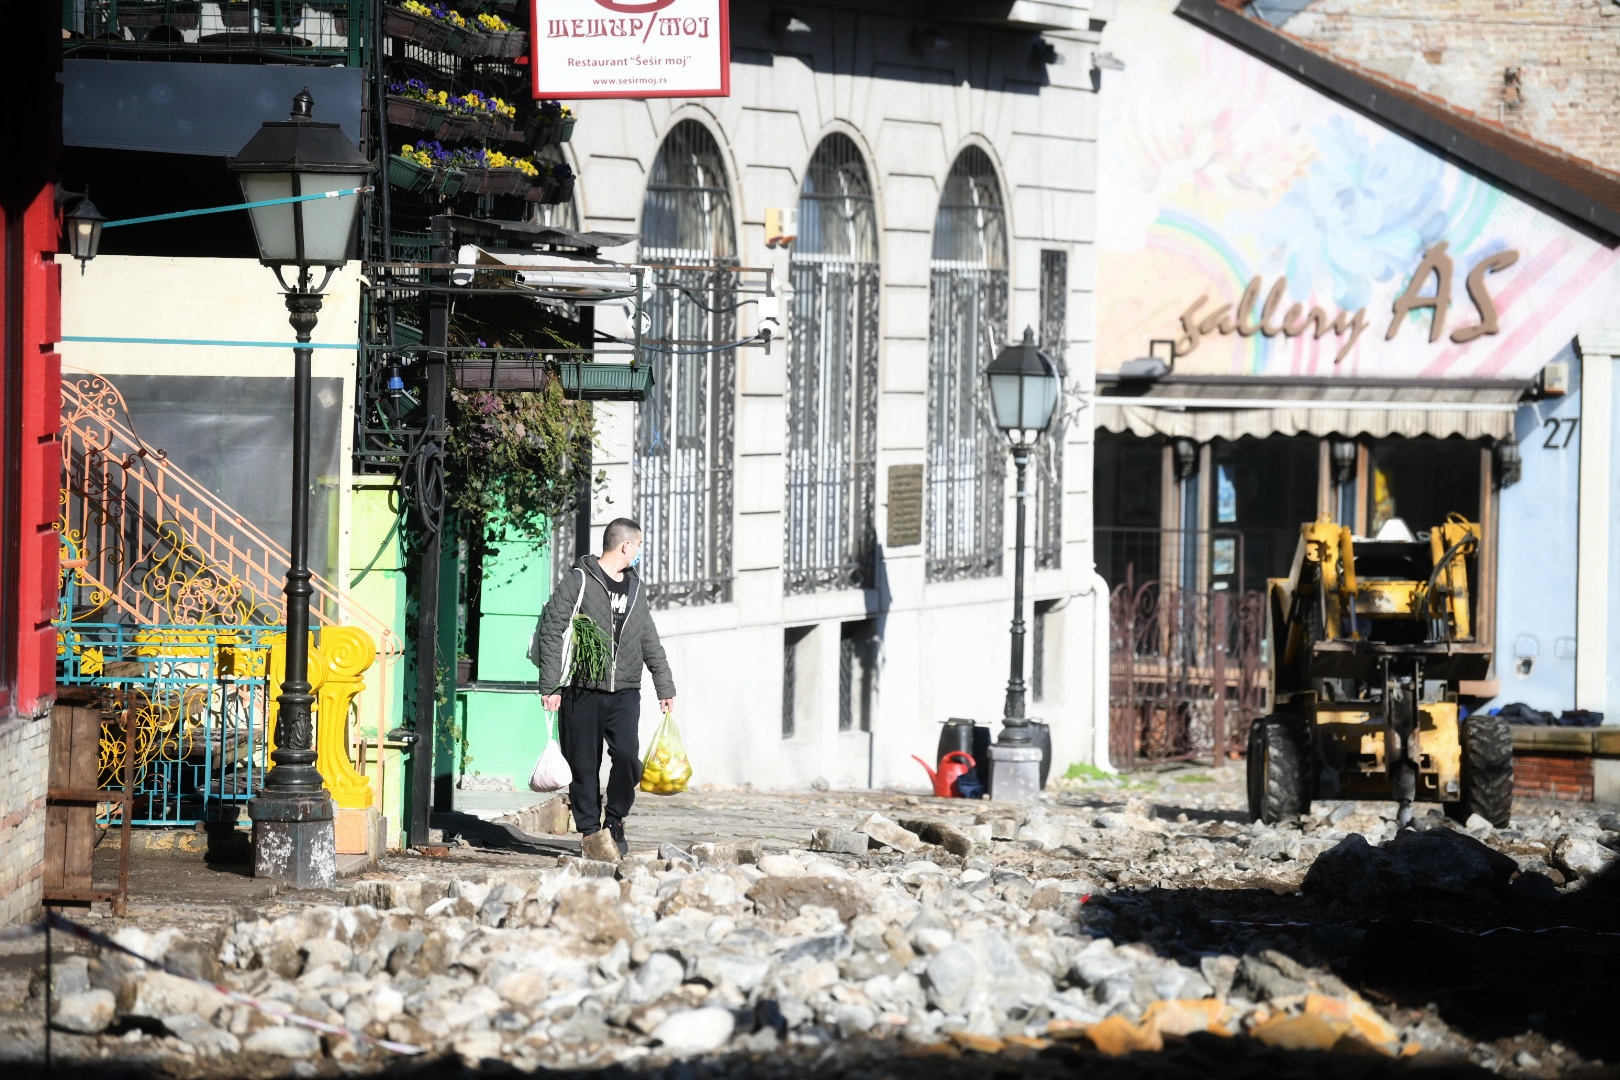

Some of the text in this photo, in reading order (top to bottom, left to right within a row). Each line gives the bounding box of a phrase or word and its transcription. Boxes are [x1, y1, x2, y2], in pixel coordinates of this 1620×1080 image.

[567, 57, 628, 67] Restaurant
[592, 76, 668, 86] www.sesirmoj.rs
[1174, 241, 1520, 365] gallery AS
[1542, 417, 1579, 450] 27
